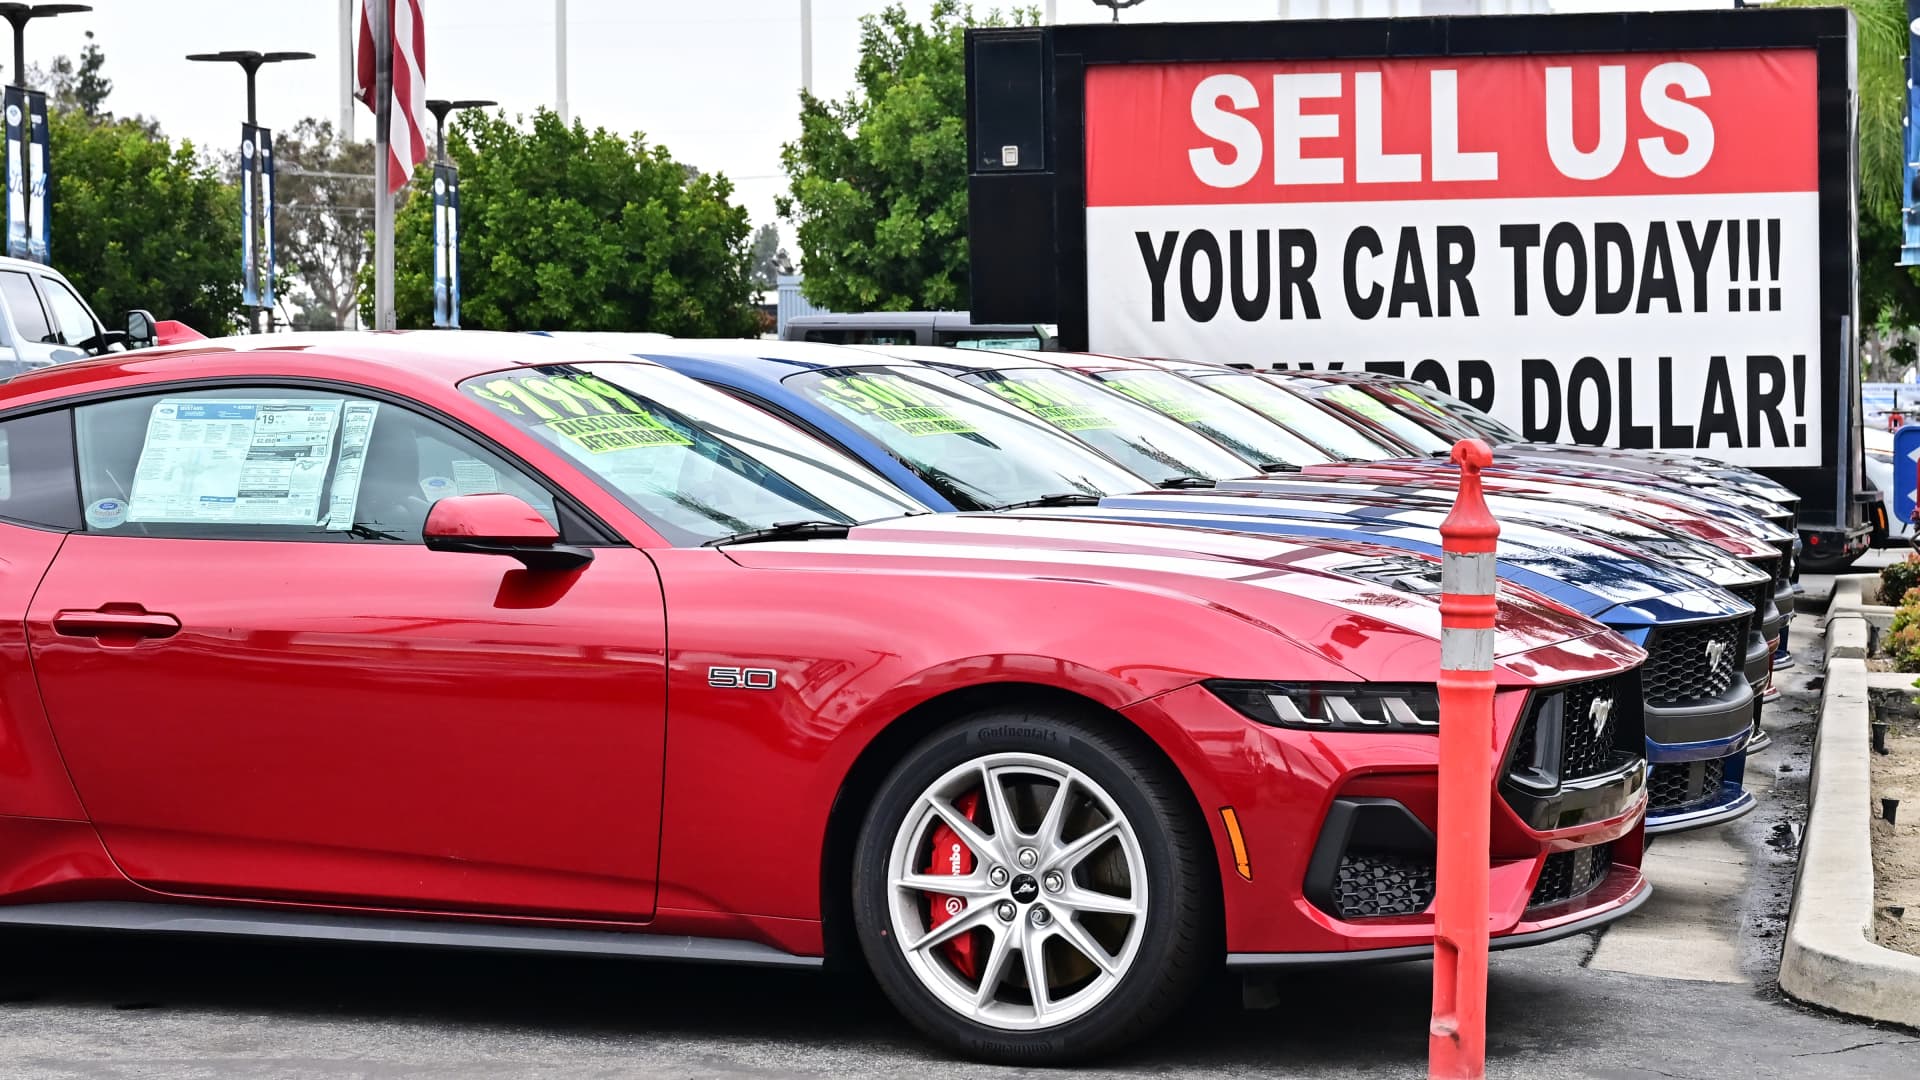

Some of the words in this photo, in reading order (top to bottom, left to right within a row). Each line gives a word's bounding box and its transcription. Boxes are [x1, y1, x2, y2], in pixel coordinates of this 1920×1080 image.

[1188, 69, 1499, 188] SELL
[1546, 62, 1715, 181] US
[1135, 228, 1322, 323] YOUR
[1343, 225, 1480, 320] CAR
[1499, 218, 1781, 317] TODAY!!!
[1521, 354, 1807, 450] DOLLAR!
[261, 414, 275, 425] 19
[554, 414, 656, 436] DISCOUNT
[578, 430, 634, 451] AFTER
[622, 428, 682, 444] REBATE
[707, 665, 777, 690] 5.0
[977, 724, 1049, 742] Continental
[949, 843, 961, 877] mbo
